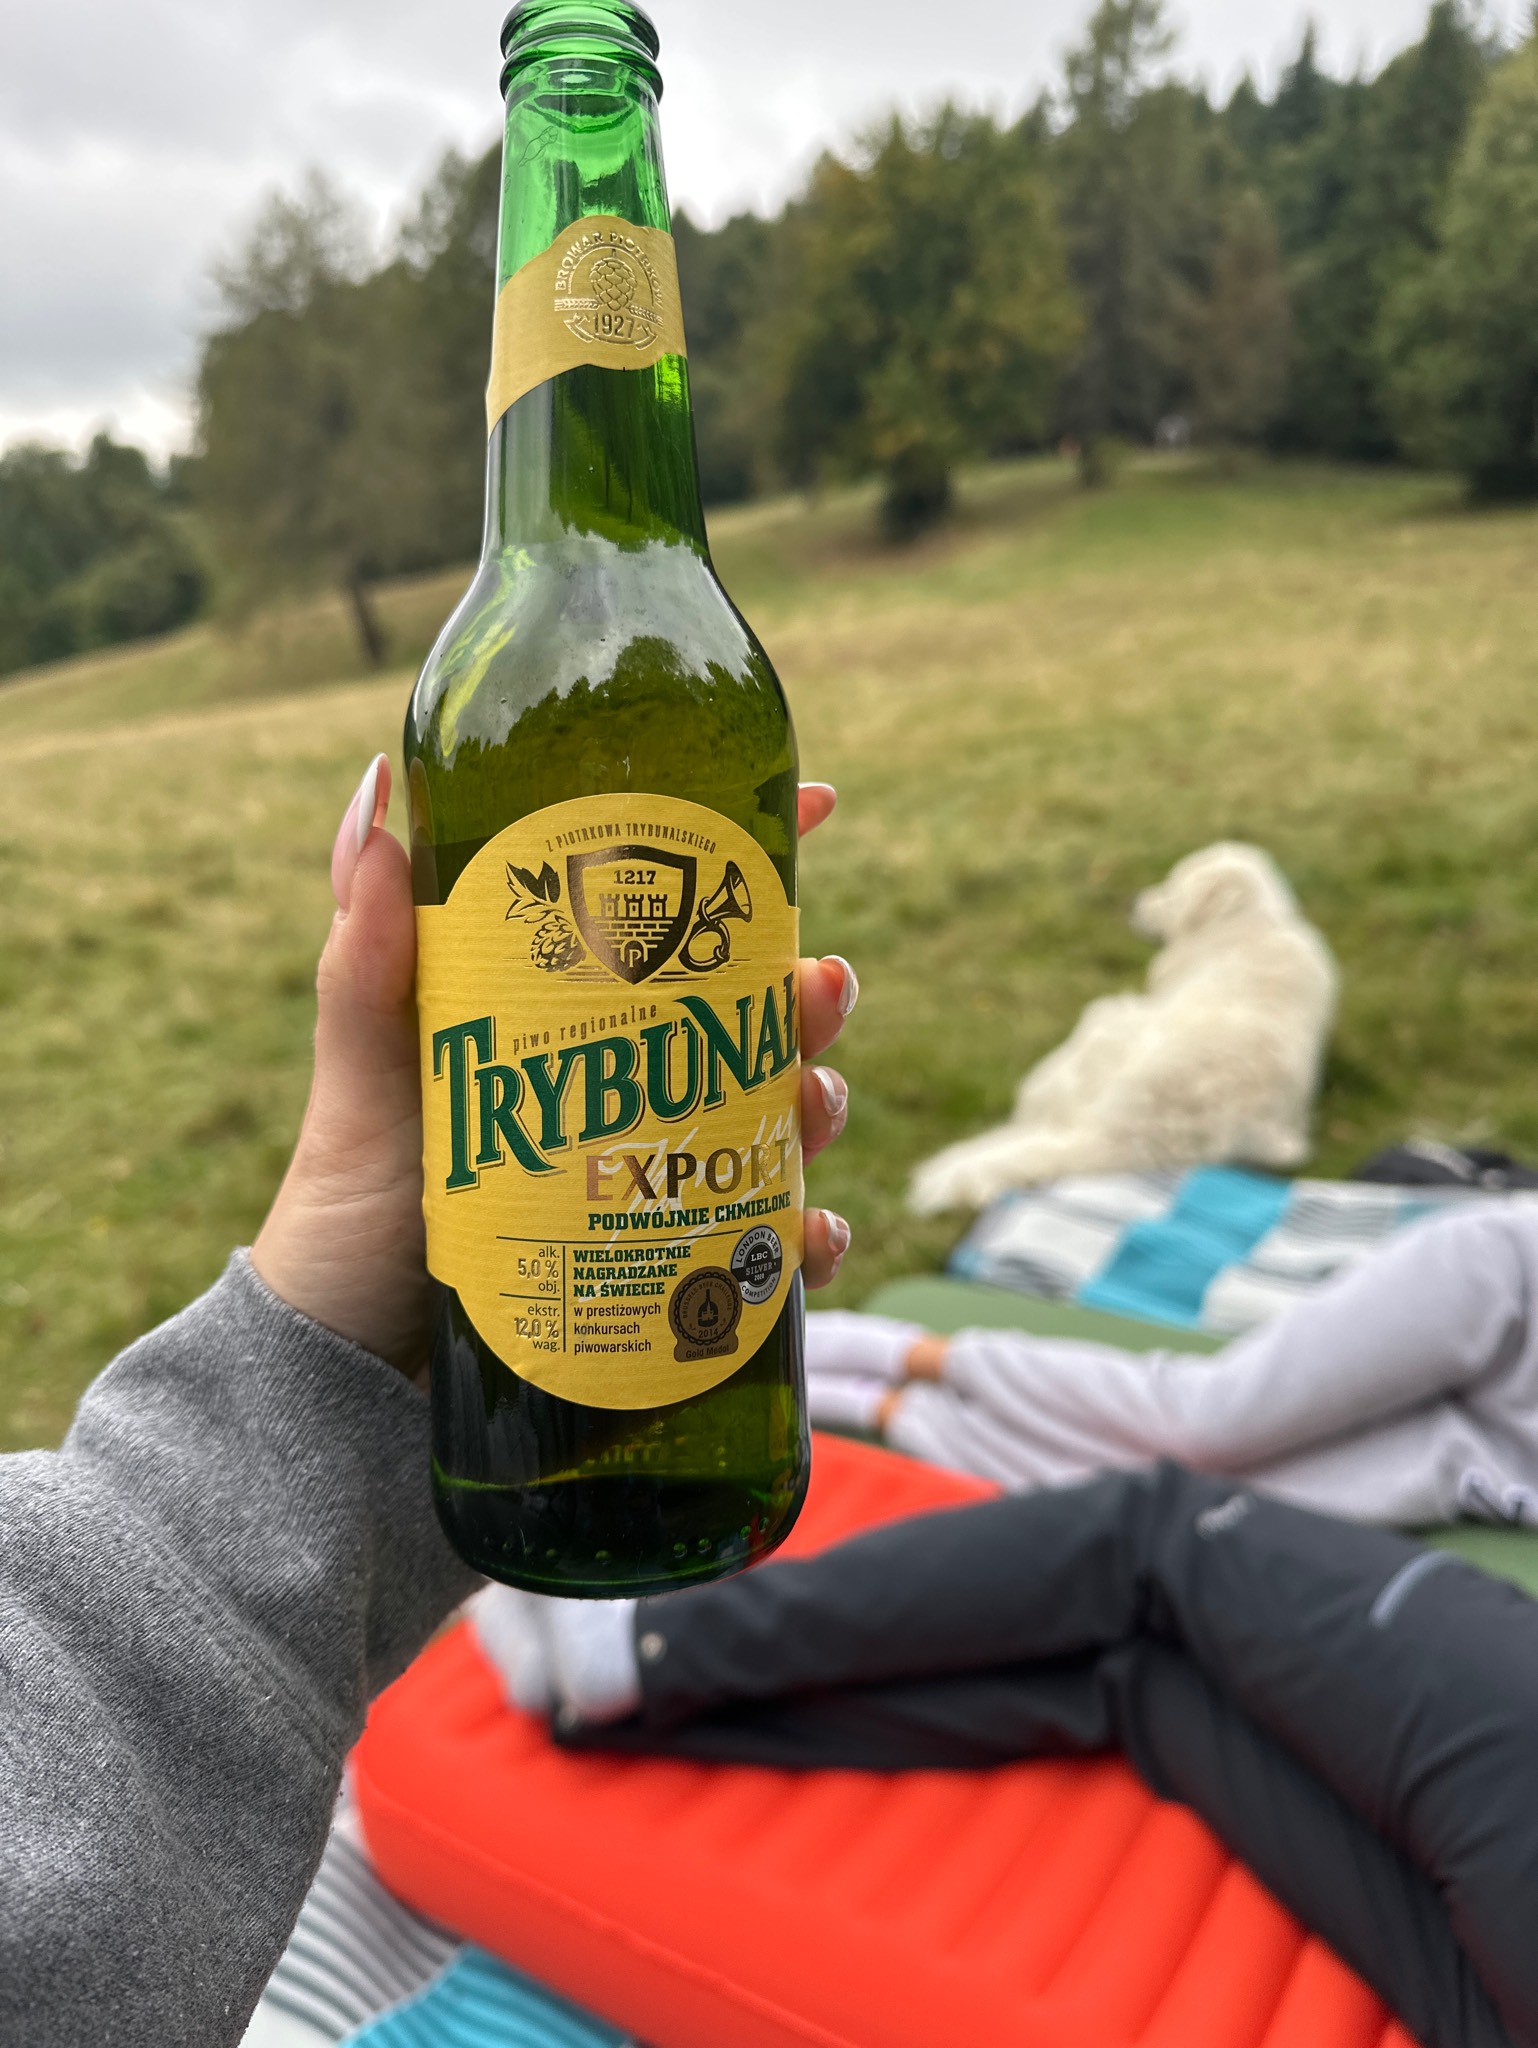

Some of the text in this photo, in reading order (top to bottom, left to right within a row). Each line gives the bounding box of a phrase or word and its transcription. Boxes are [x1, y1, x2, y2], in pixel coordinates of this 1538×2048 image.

[554, 231, 603, 291] BROWAR
[593, 312, 635, 340] 1927
[545, 823, 717, 854] Z PIOTRKOWA TRYBUNALSKIEGO
[614, 870, 656, 885] 1217
[513, 1003, 657, 1056] piwo regionalne
[586, 1137, 789, 1201] EXPORT
[588, 1190, 791, 1231] PODWÓJNIE CHMIELONE
[538, 1246, 560, 1259] alk.
[573, 1246, 691, 1263] WIELOKROTNIE
[736, 1231, 780, 1263] LONDON BEER
[751, 1251, 768, 1262] LBC
[573, 1264, 678, 1281] NAGRADZANE
[745, 1261, 773, 1277] SILVER
[538, 1281, 560, 1294] obj.
[573, 1282, 665, 1298] NA ŚWIECIE
[741, 1276, 776, 1298] COMPETITION
[527, 1304, 560, 1317] ekstr.
[573, 1303, 661, 1319] w prestiżowych
[573, 1322, 640, 1335] konkursach
[698, 1328, 719, 1339] 2014
[533, 1340, 560, 1352] wag.
[574, 1339, 652, 1355] piwowarskich
[686, 1344, 730, 1359] Gold Medal
